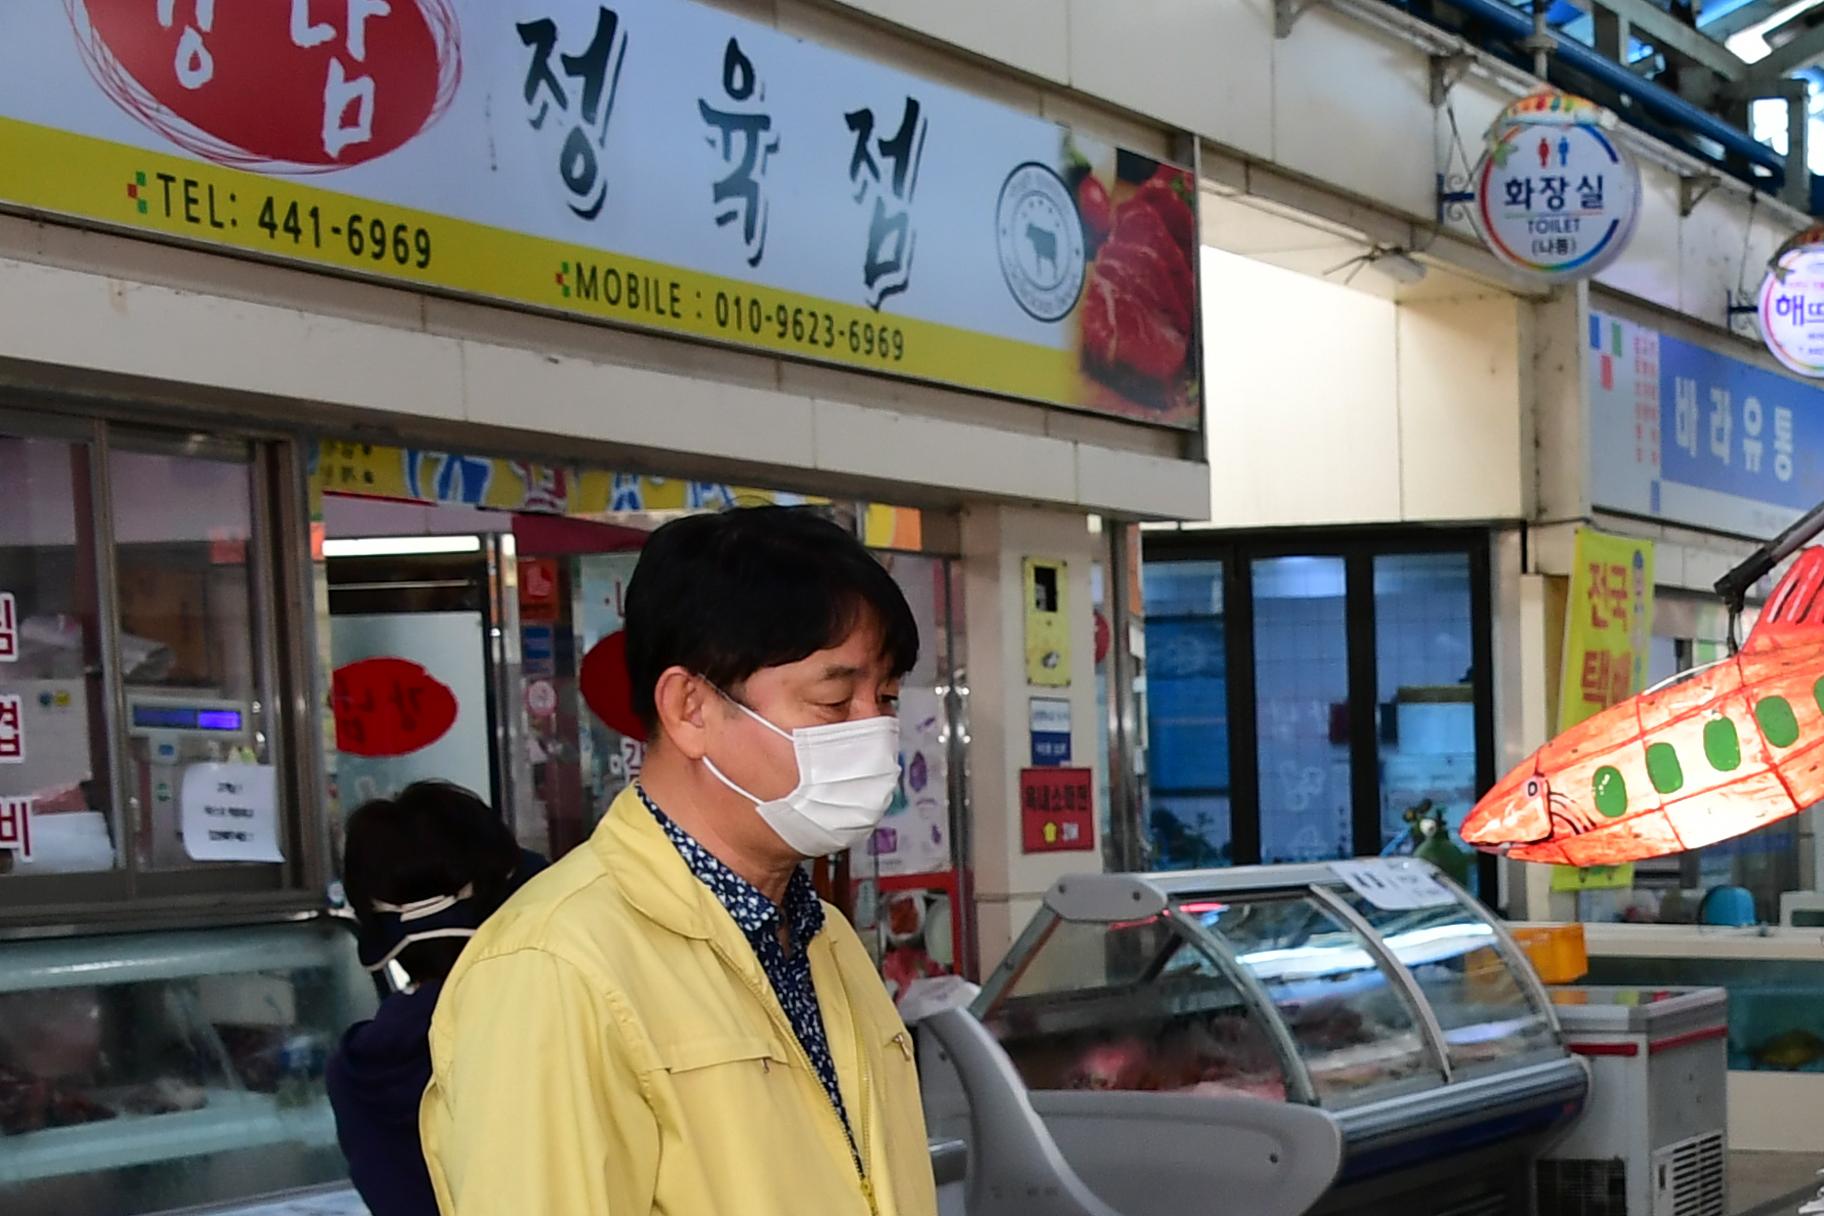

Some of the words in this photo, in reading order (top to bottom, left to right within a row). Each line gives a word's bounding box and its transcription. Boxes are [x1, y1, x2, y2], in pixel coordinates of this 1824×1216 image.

[157, 172, 238, 228] TEL:
[258, 196, 432, 269] 441-6969
[1503, 174, 1604, 210] 화장실
[1528, 218, 1581, 234] TOILET
[575, 262, 681, 319] MOBILE
[714, 291, 904, 361] 010-9623-6969
